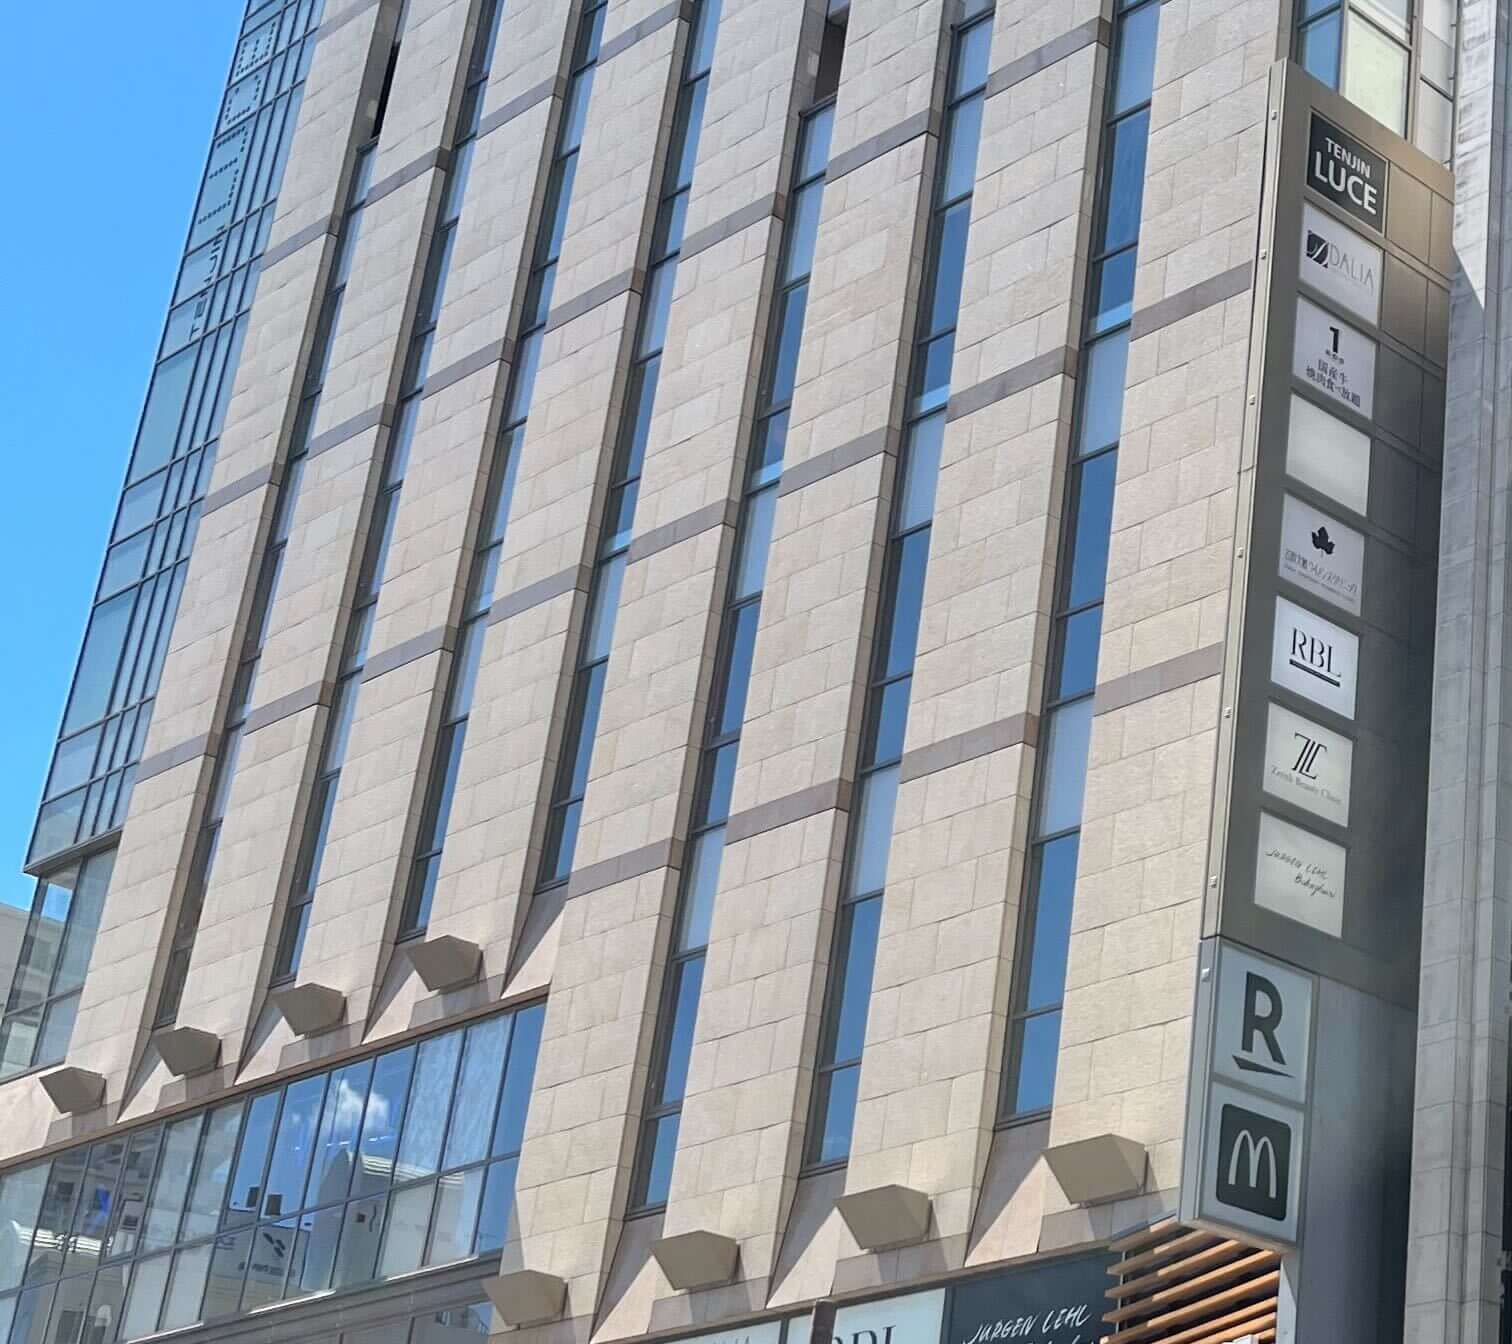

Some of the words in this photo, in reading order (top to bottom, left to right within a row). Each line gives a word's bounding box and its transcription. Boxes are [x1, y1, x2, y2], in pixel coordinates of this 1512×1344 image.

[1314, 151, 1378, 215] LUCE
[1325, 137, 1371, 179] TENJIN
[1291, 627, 1342, 678] RBL
